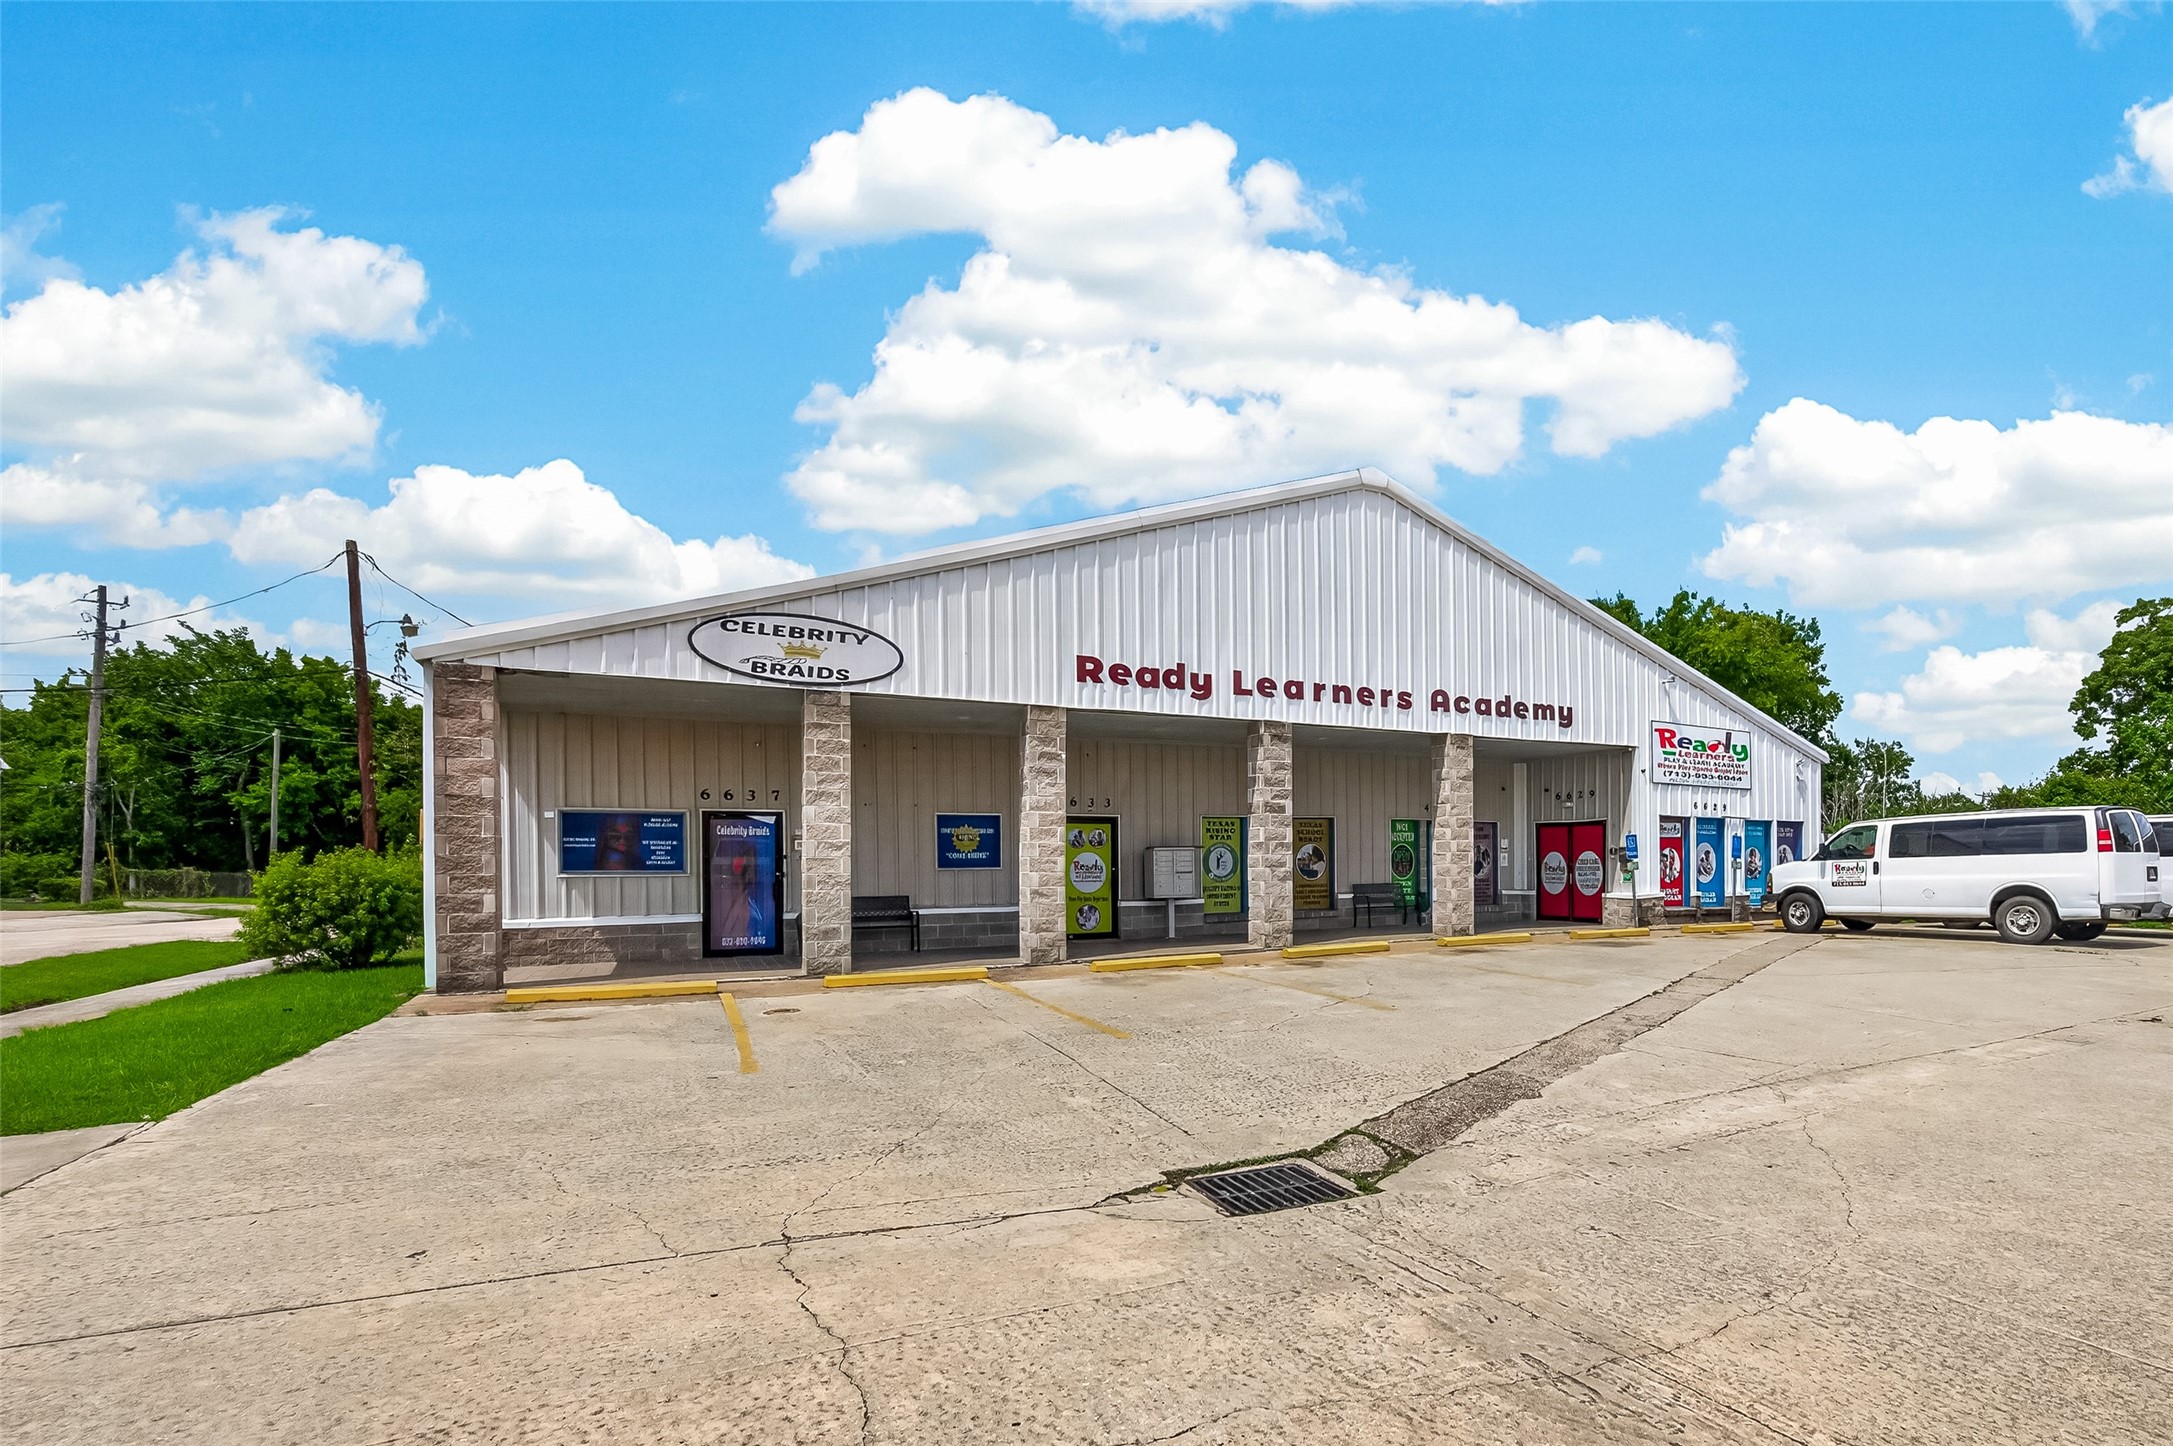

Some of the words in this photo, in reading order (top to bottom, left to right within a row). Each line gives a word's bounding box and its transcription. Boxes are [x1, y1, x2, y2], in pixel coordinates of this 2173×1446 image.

[720, 619, 869, 646] CELEBRITY
[750, 660, 850, 681] BRAIDS
[1076, 654, 1213, 701] Ready
[1233, 670, 1413, 709] Learners
[1431, 689, 1574, 728] Academy
[1654, 728, 1749, 762] Ready
[1663, 756, 1681, 764] PLAY
[1712, 761, 1745, 770] ACADEMY
[1678, 749, 1735, 763] Learners
[700, 788, 780, 801] 6637
[1555, 789, 1596, 800] 6629
[1693, 801, 1727, 812] 6629
[716, 825, 747, 838] Celebrity
[748, 826, 770, 836] Braids
[1834, 862, 1865, 874] Ready
